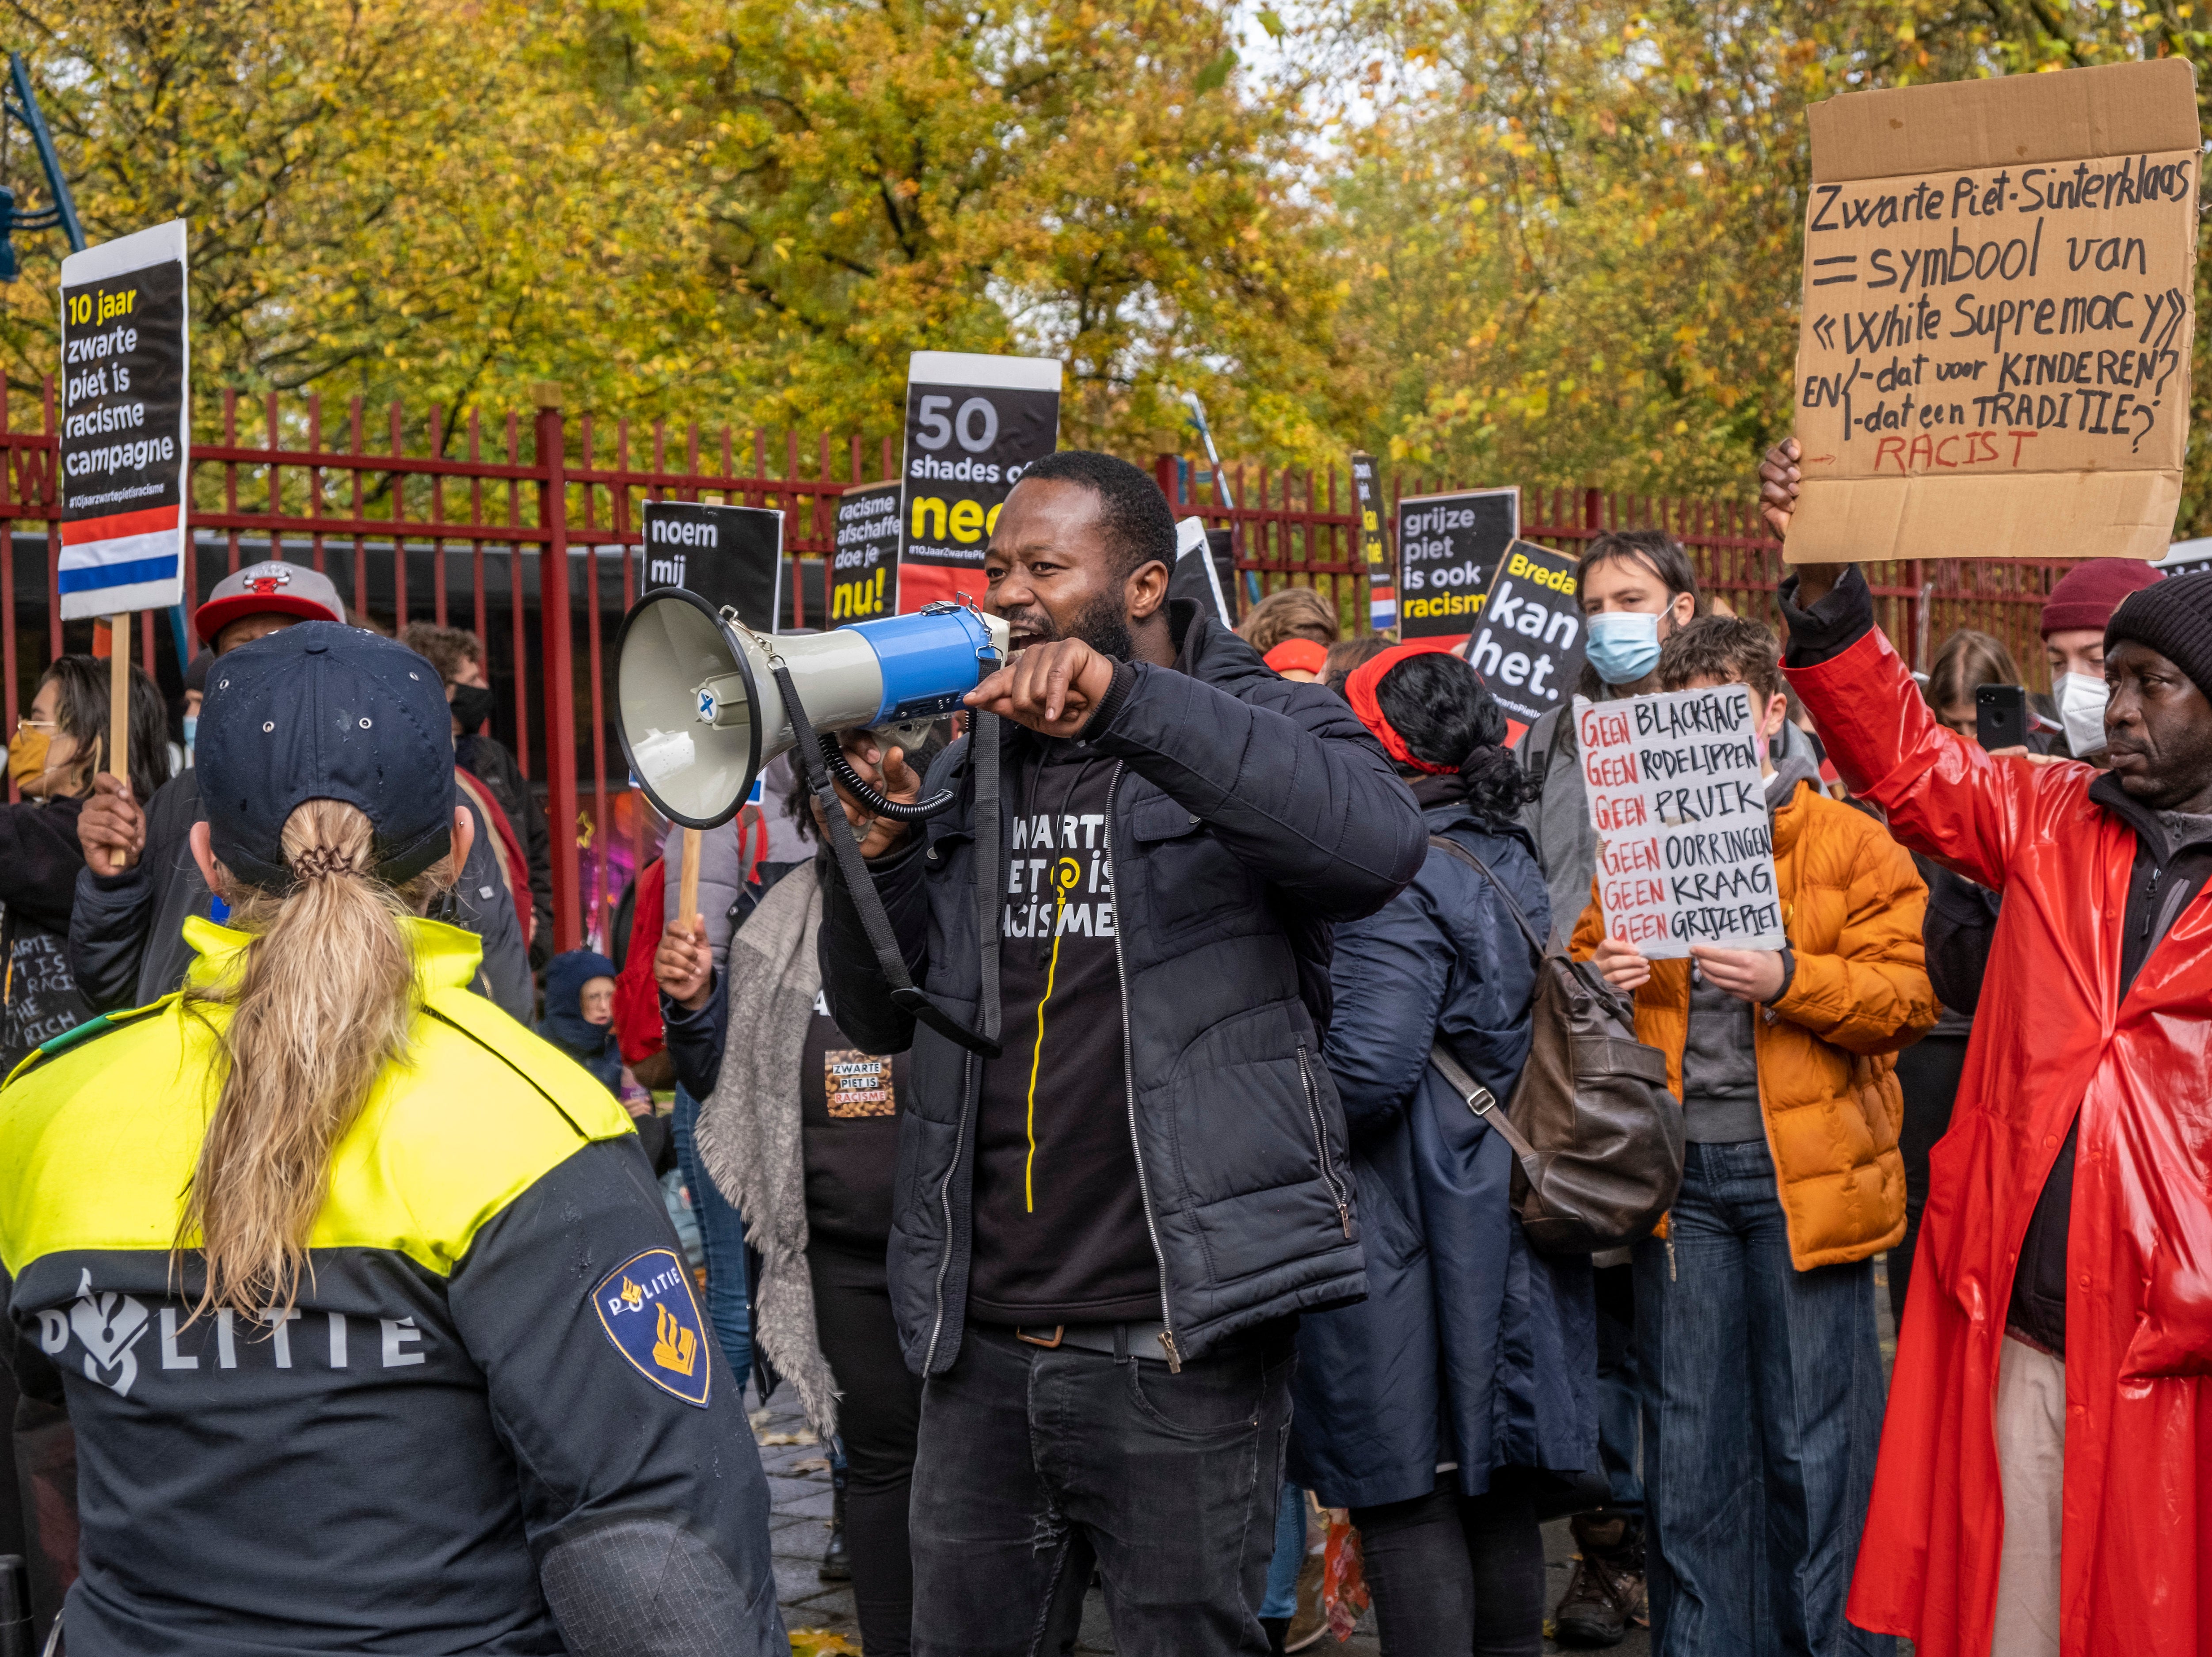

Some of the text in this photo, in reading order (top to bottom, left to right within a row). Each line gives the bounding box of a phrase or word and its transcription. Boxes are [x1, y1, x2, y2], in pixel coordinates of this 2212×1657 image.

[1811, 182, 1943, 231] Zwarte
[2067, 234, 2147, 274] van
[69, 287, 137, 327] 10 jaar
[68, 325, 137, 364] zwarte
[69, 362, 129, 407] piet is
[1937, 360, 1988, 381] voor
[1999, 350, 2179, 406] KINDEREN?
[66, 402, 145, 438] racisme
[916, 395, 999, 453] 50
[1919, 403, 1964, 429] een
[1974, 389, 2155, 453] TRADITIE?
[67, 435, 174, 476] campagne
[910, 454, 1001, 484] shades
[1874, 430, 2037, 477] RACIST
[839, 496, 896, 522] racisme
[1405, 507, 1475, 537] grijze
[652, 519, 718, 548] noem
[1405, 535, 1454, 564] piet
[651, 554, 686, 588] mij
[835, 543, 880, 570] doe je
[1403, 561, 1481, 590] is ook
[1507, 553, 1576, 596] Breda
[832, 567, 886, 619] nu!
[1488, 581, 1579, 650] kan
[1468, 628, 1559, 701] het.
[1582, 693, 1749, 748] GEEN BLACKFACE
[1587, 750, 1639, 788] GEEN
[1595, 780, 1765, 831] GEEN PRUIK
[1603, 825, 1773, 876] GEEN OORRINGEN
[1604, 863, 1772, 912] GEEN KRAAG
[1612, 913, 1668, 943] GEEN
[834, 1063, 879, 1074] ZWARTE
[841, 1078, 876, 1088] PIET IS
[836, 1091, 884, 1102] RACISME
